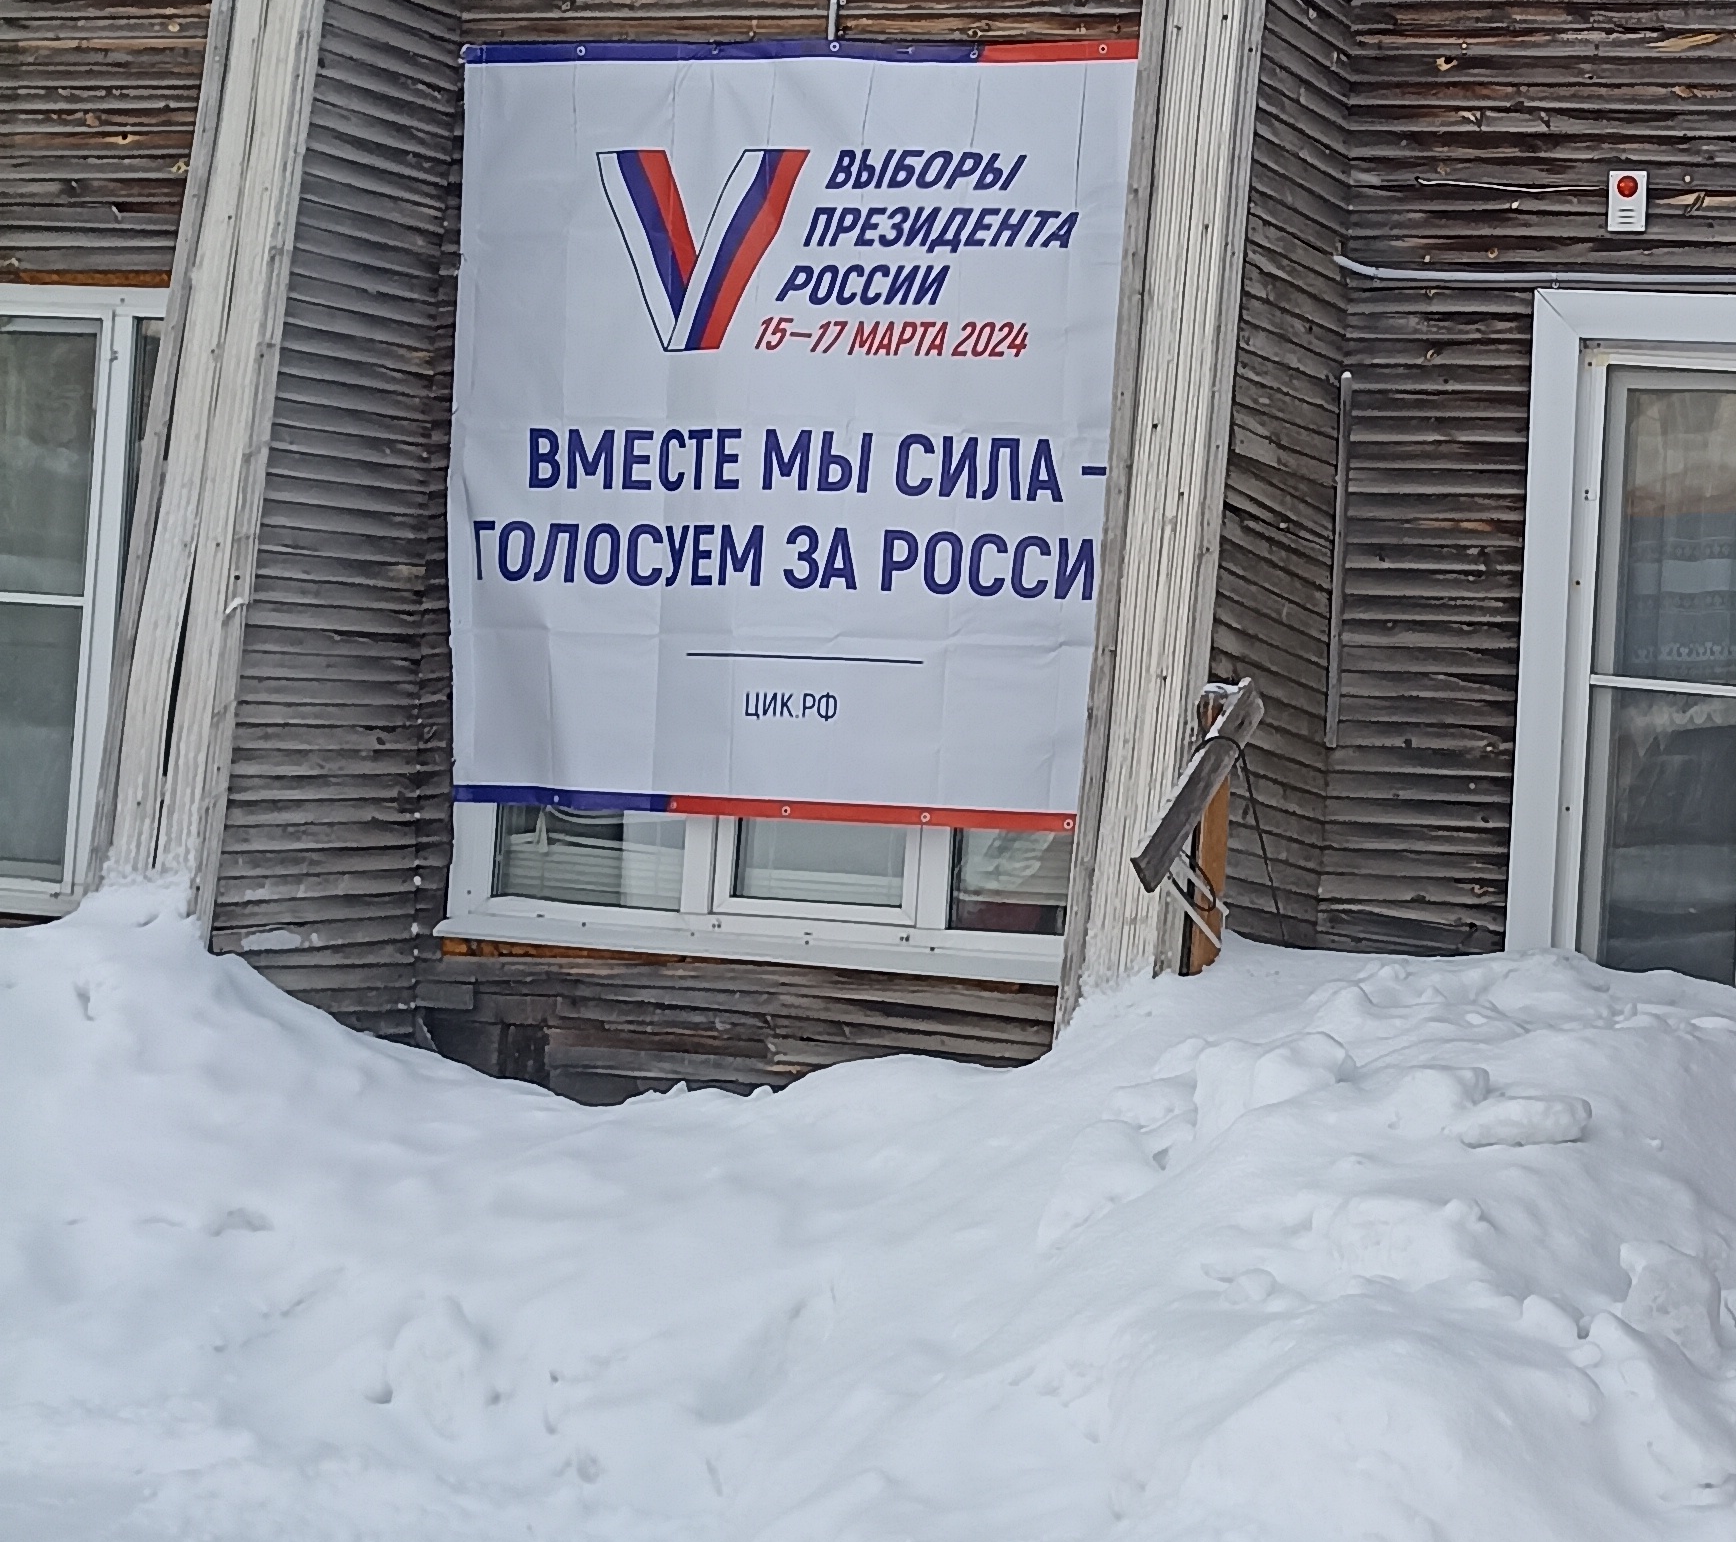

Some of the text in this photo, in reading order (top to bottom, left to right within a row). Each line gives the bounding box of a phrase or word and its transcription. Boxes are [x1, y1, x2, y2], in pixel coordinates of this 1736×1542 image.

[825, 149, 1028, 191] ВЫБОРЫ
[803, 207, 1080, 253] ПРЕЗИДЕНТА
[775, 264, 951, 306] РОССИИ
[847, 317, 949, 358] МАРТА
[950, 321, 1029, 359] 2024
[528, 427, 742, 491] ВМЕСТЕ
[762, 429, 873, 494] МЫ
[893, 433, 1064, 503] СИЛА
[473, 520, 1095, 601] ГОЛОСУЕМ ЗА РОССИ
[743, 691, 838, 723] ЦИК.РФ
